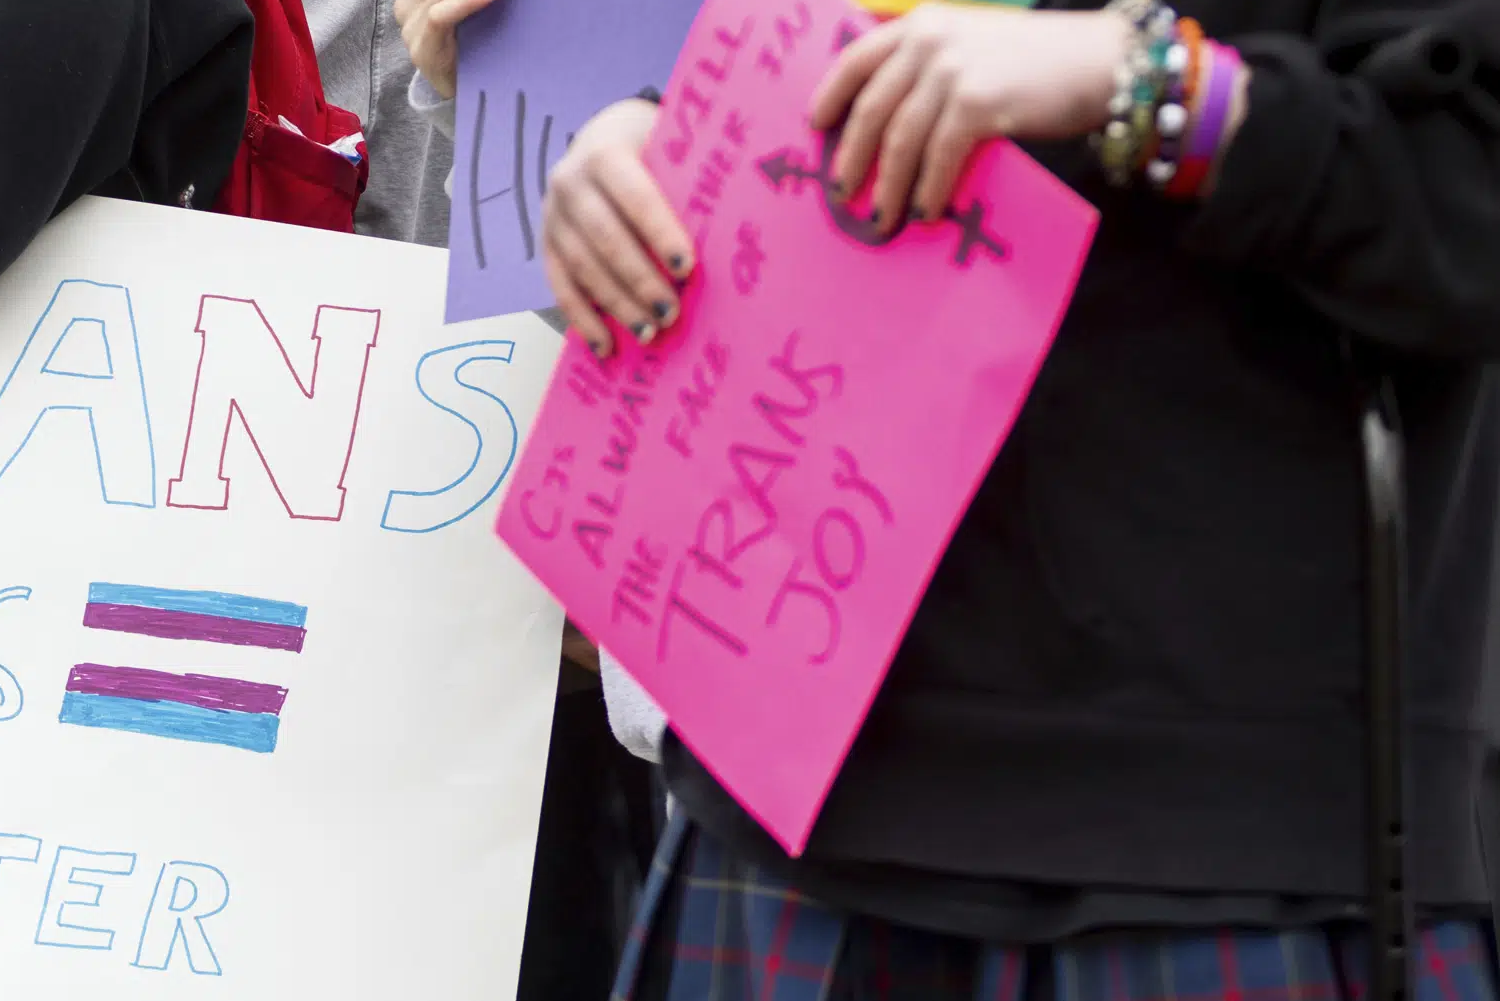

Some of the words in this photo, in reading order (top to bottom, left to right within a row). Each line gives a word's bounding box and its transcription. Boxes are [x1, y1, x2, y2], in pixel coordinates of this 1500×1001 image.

[609, 534, 669, 628] THE
[655, 326, 845, 665] TRANS
[762, 443, 898, 667] JOY
